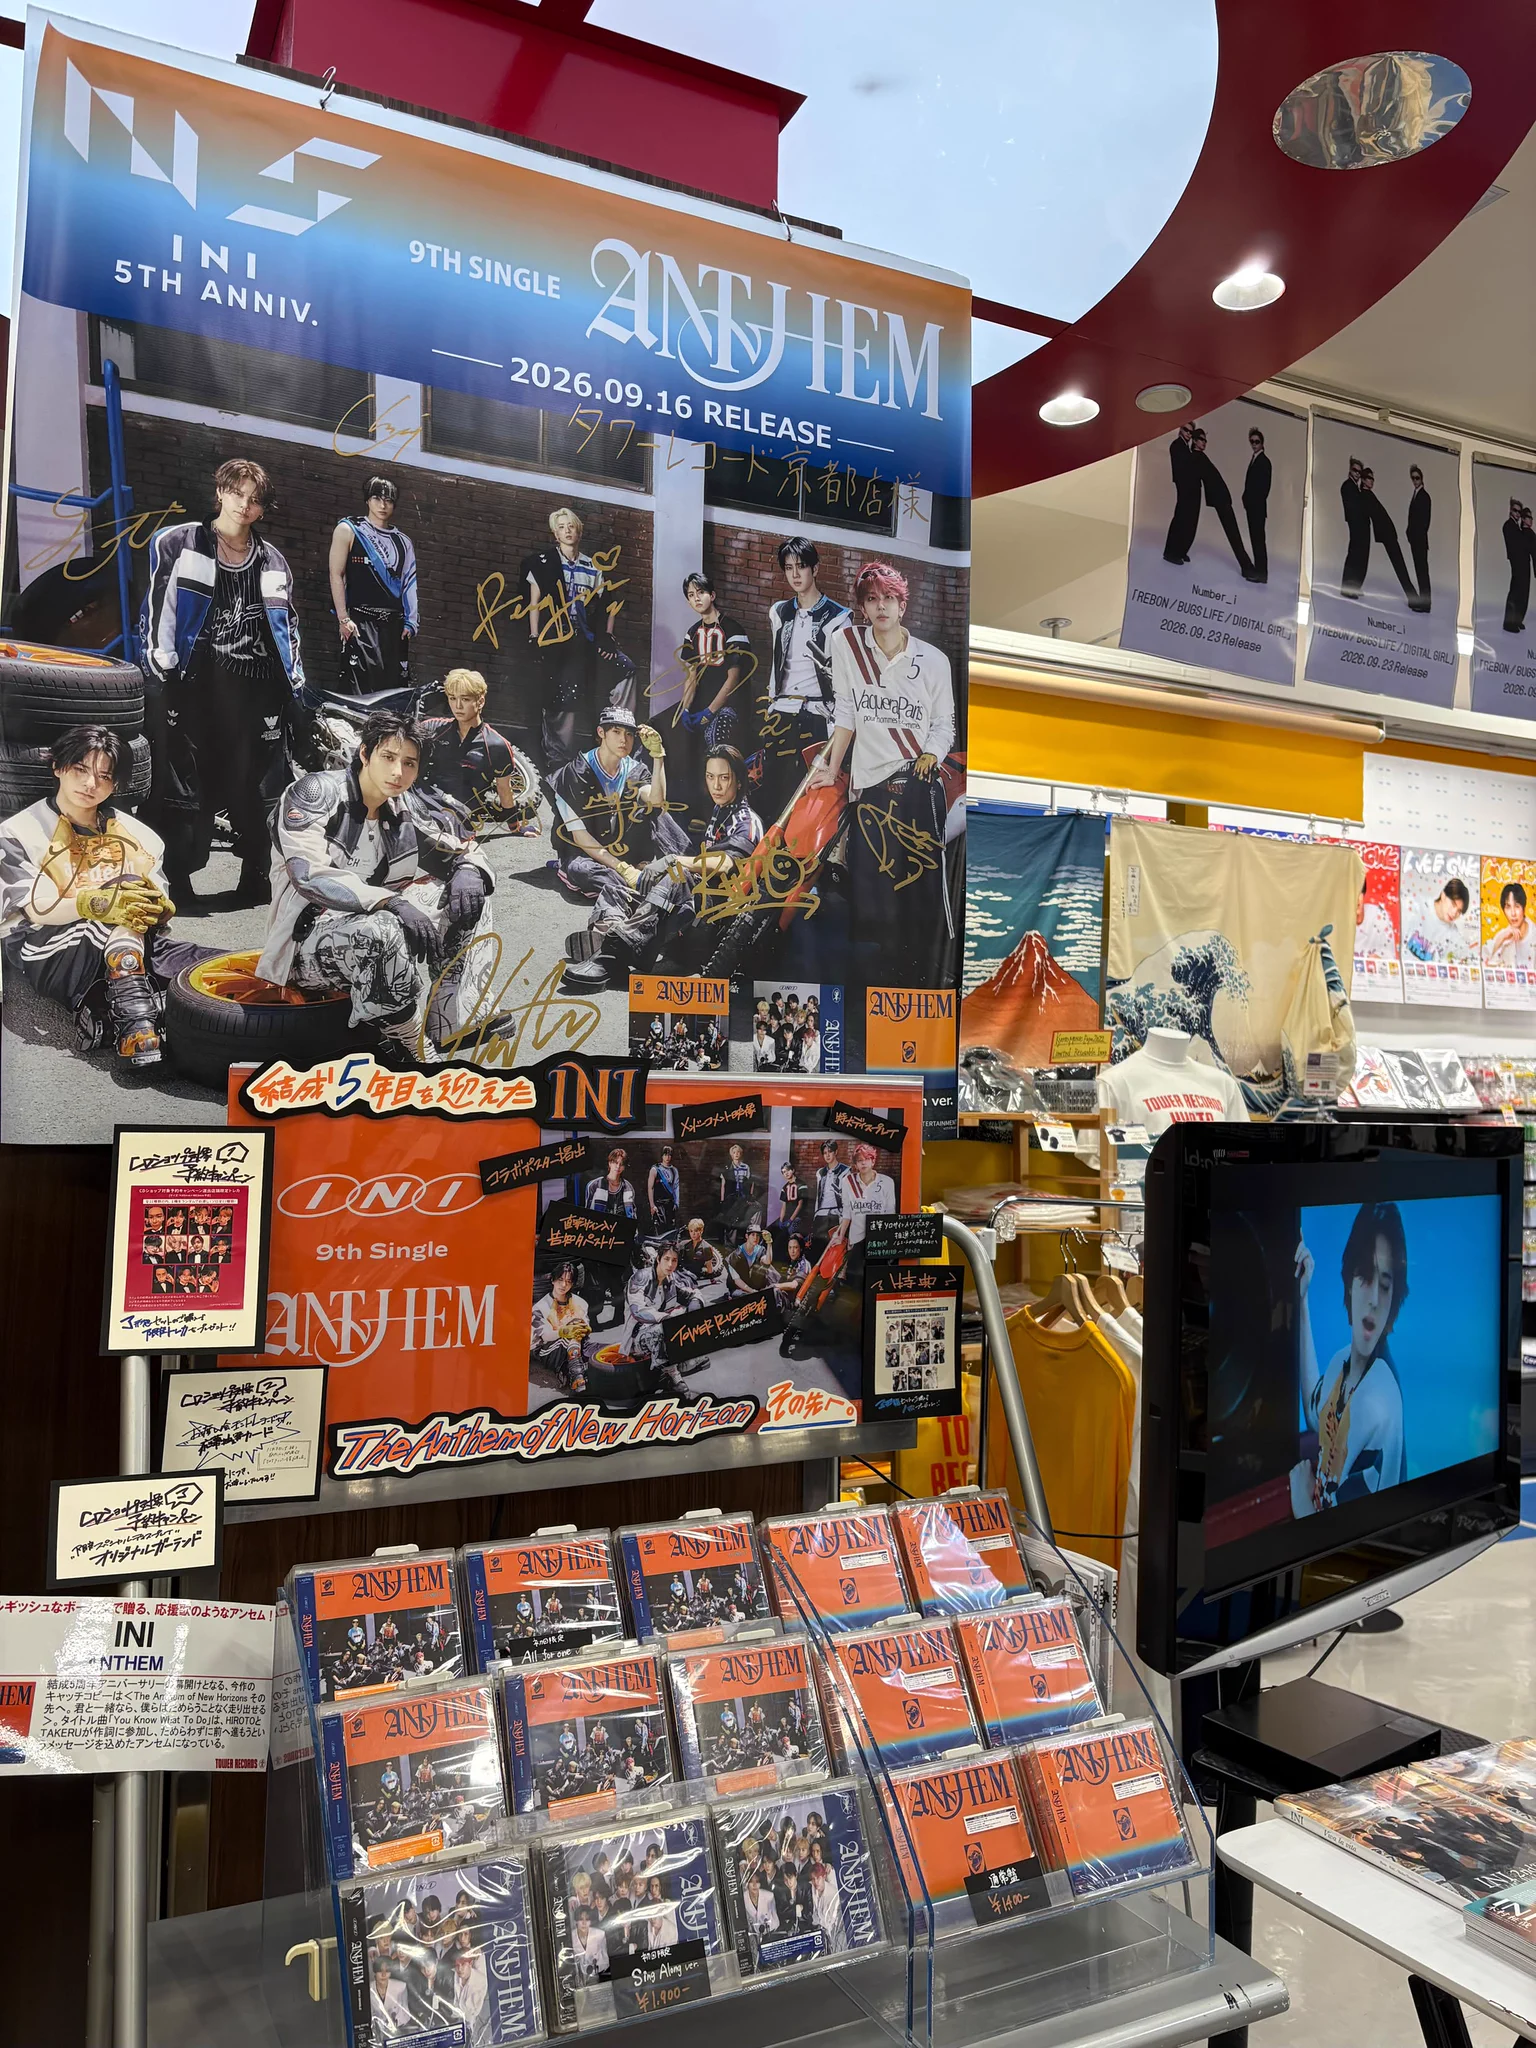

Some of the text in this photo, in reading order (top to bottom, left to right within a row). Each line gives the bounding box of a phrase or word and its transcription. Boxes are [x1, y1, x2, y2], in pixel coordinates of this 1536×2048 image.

[172, 233, 257, 281] INI
[408, 239, 562, 300] 9TH SINGLE
[113, 258, 319, 327] 5TH ANNIV.
[585, 237, 945, 422] ANTHEM
[509, 356, 833, 450] 2026.09.16 RELEASE
[1191, 583, 1238, 606] Number_i
[1177, 601, 1203, 618] BUGS
[1203, 606, 1224, 623] LIFE
[1232, 614, 1266, 634] DIGITAL
[1367, 616, 1406, 636] Number_i
[1160, 619, 1262, 654] 2026.09.23 Release
[906, 654, 924, 680] 5
[1340, 650, 1429, 679] 2026.09.23 Release
[1503, 683, 1536, 699] 2026.09
[656, 980, 726, 1006] ANTHEM
[869, 991, 954, 1022] ANTHEM
[250, 1056, 533, 1111] 結成5年目を迎えた
[546, 1062, 639, 1125] INI
[931, 1097, 953, 1107] ver.
[1142, 1093, 1225, 1113] TOWER RECORDS
[485, 1142, 586, 1188] コラボポスター掲出
[315, 1242, 449, 1263] 9th Single
[263, 1284, 500, 1368] ANTHEM
[768, 1382, 856, 1421] その先へ。
[338, 1430, 413, 1470] The
[402, 1415, 524, 1469] Anthem
[520, 1408, 562, 1454] of
[550, 1404, 628, 1450] New
[630, 1400, 754, 1441] Horizon
[668, 1526, 748, 1560] ANTHEM
[788, 1516, 885, 1559] ANTHEM
[517, 1543, 603, 1578] ANTHEM
[352, 1565, 445, 1601] ANTHEM
[115, 1620, 155, 1648] INI
[88, 1655, 164, 1672] NTHEM
[521, 1649, 538, 1665] All
[541, 1648, 555, 1661] for
[557, 1648, 572, 1658] one
[719, 1646, 803, 1686] ANTHEM
[847, 1629, 951, 1678] ANTHEM
[187, 1691, 196, 1701] of
[198, 1692, 215, 1701] New
[216, 1692, 248, 1702] Horizons
[249, 1693, 267, 1704] その
[133, 1717, 160, 1726] Know
[183, 1716, 195, 1726] To
[215, 1758, 258, 1769] TOWER RECORDS
[1056, 1732, 1155, 1786] ANTHEM
[906, 1764, 1013, 1820] ANTHEM
[1290, 1811, 1304, 1826] INI
[725, 1856, 738, 1897] ANTHEM
[837, 1839, 876, 1943] ANTHEM
[988, 1867, 1021, 1889] 通常盤
[349, 1940, 365, 1986] ANTHEM
[488, 1920, 529, 2040] ANTHEM
[631, 1960, 700, 1987] Sing Along ver.
